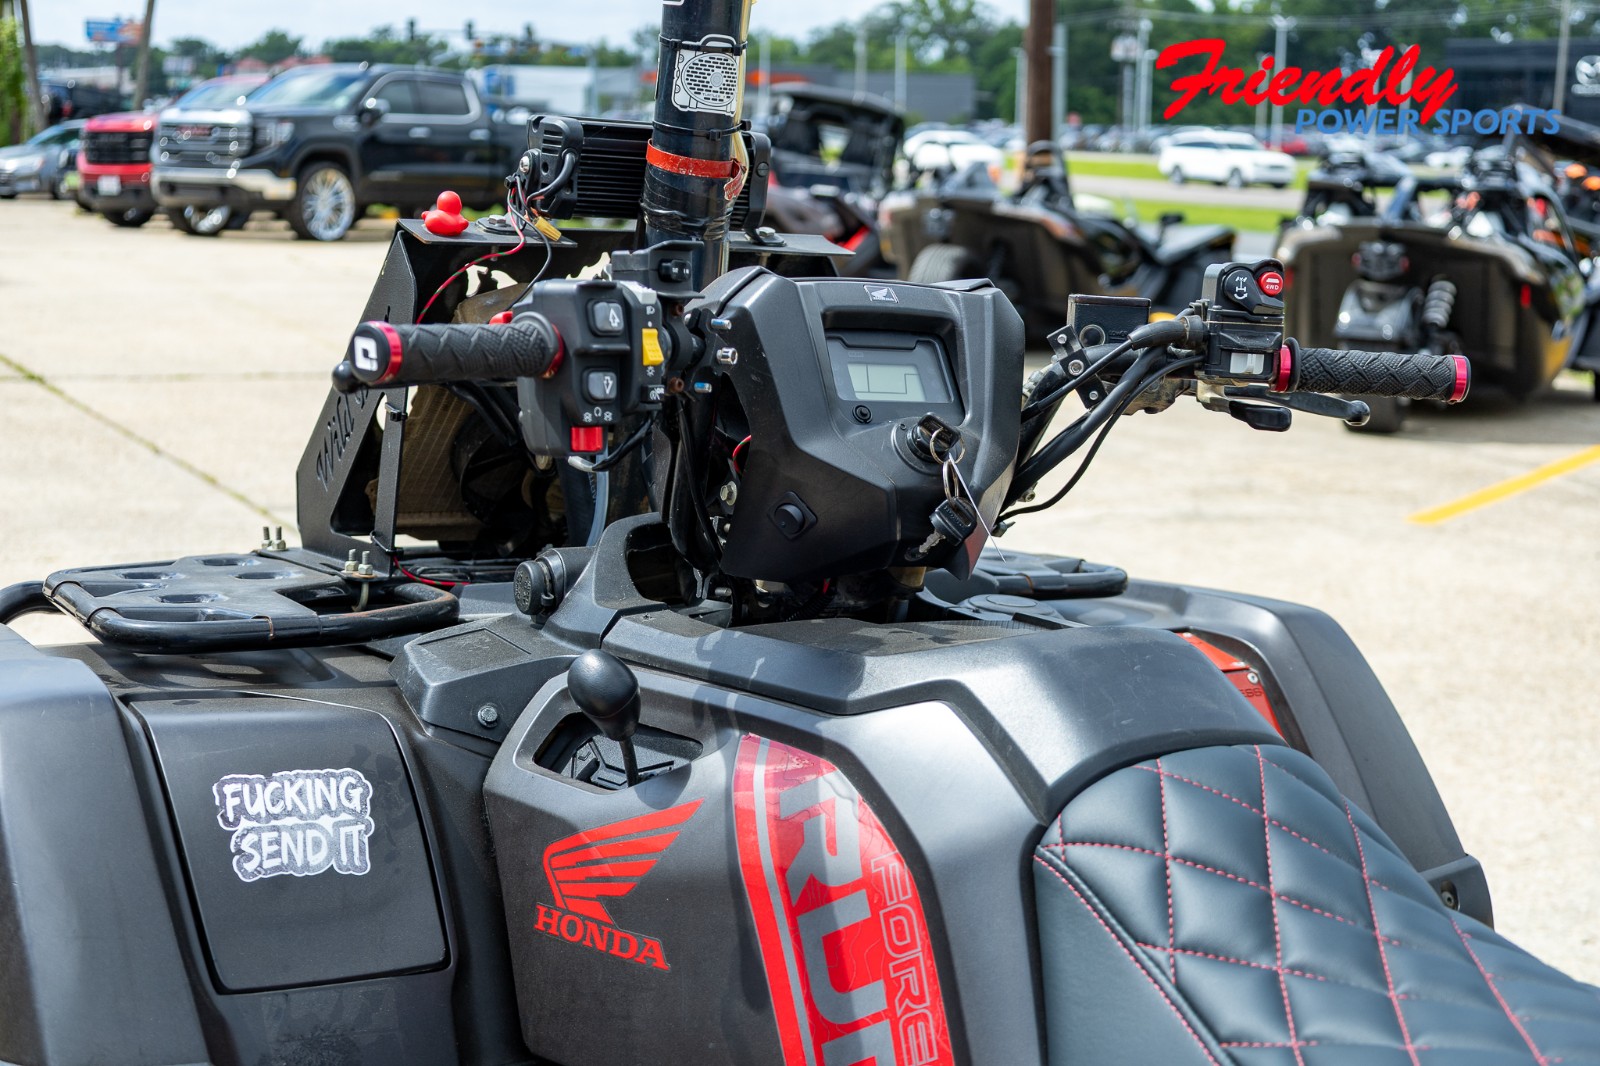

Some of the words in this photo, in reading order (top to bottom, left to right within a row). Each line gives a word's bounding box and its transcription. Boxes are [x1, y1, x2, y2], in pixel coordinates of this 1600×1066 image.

[222, 775, 364, 823] FUCKING
[239, 828, 328, 872] SEND
[337, 823, 367, 867] IT
[533, 904, 670, 971] HONDA
[870, 849, 939, 1066] FORE
